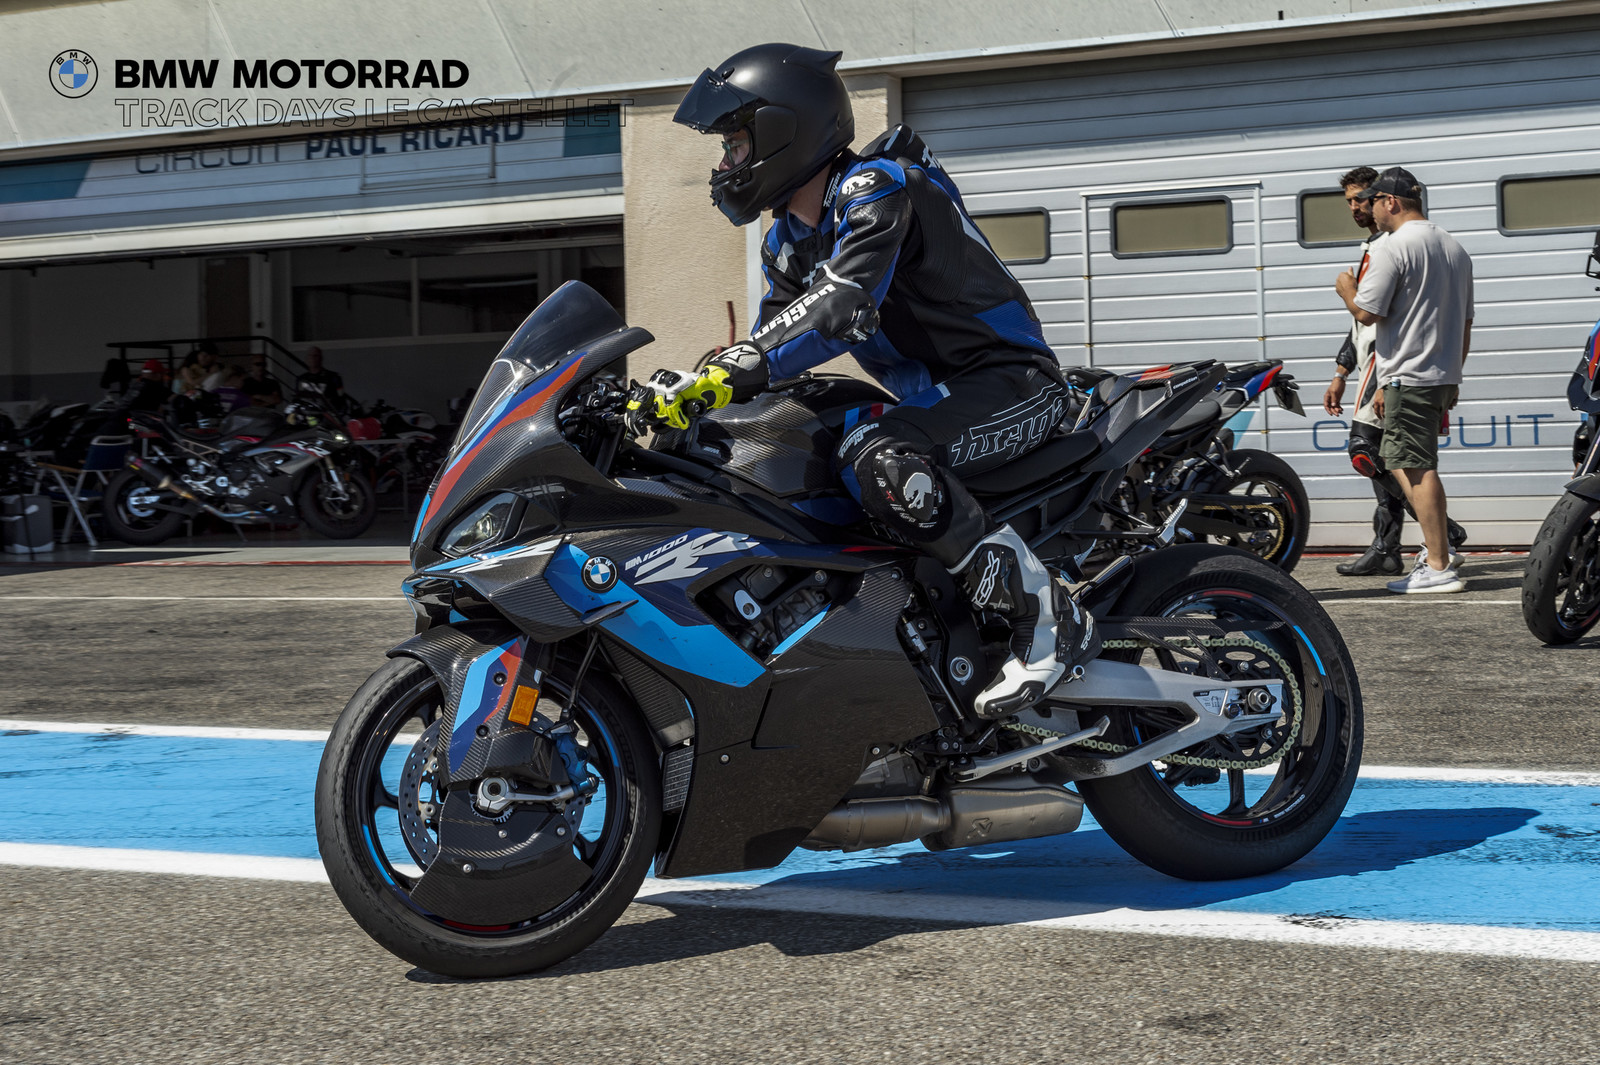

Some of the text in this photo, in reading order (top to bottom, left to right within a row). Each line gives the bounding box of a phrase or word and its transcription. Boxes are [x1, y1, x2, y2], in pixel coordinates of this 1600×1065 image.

[305, 130, 387, 160] PAUL
[401, 119, 525, 152] RICARD
[1312, 413, 1554, 451] CUIT
